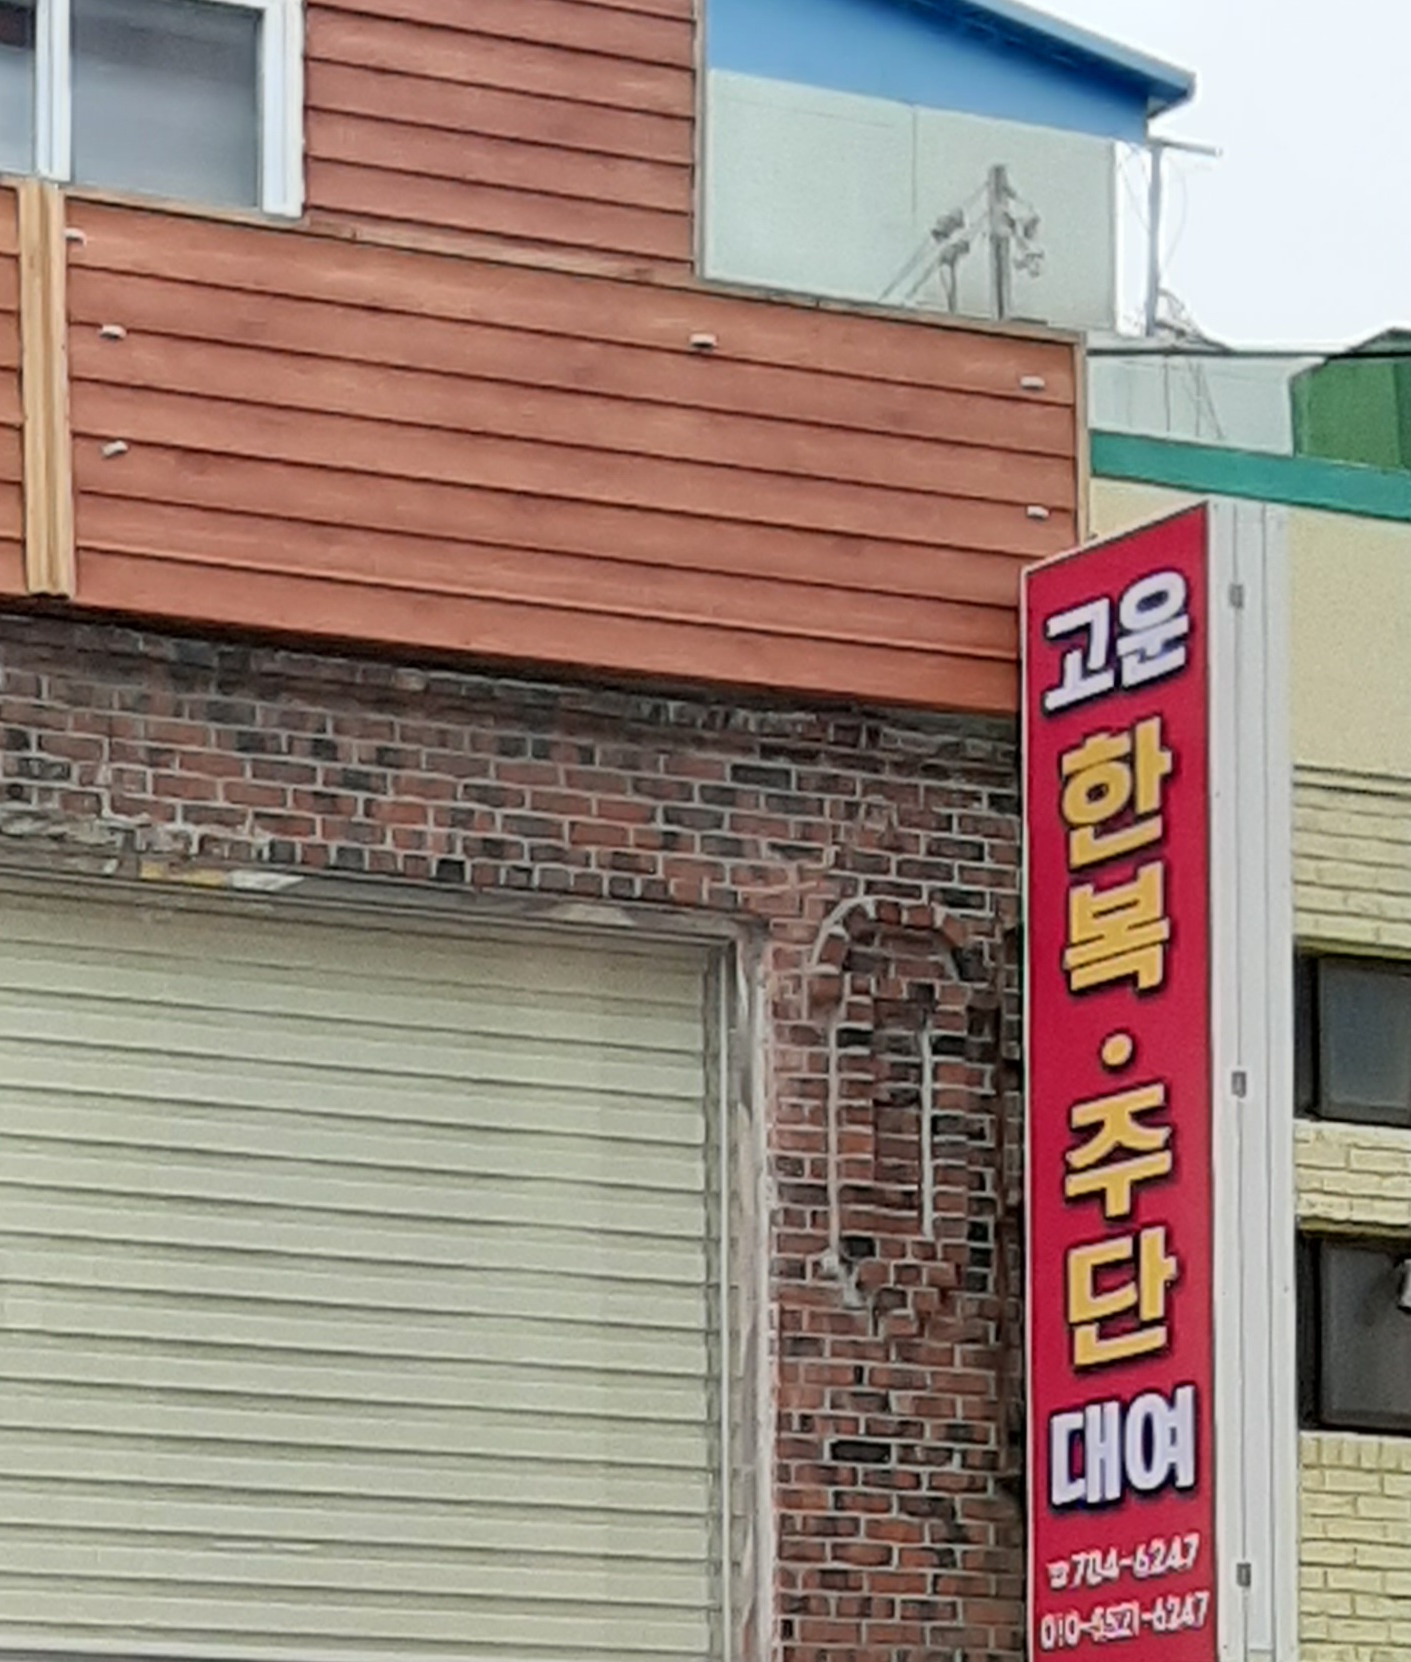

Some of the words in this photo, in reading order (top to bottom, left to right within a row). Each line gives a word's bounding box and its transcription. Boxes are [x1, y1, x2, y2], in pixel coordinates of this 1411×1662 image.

[1043, 570, 1190, 713] 고운
[1060, 715, 1173, 993] 한복
[1063, 1083, 1176, 1368] 주단
[1048, 1385, 1197, 1507] 대여
